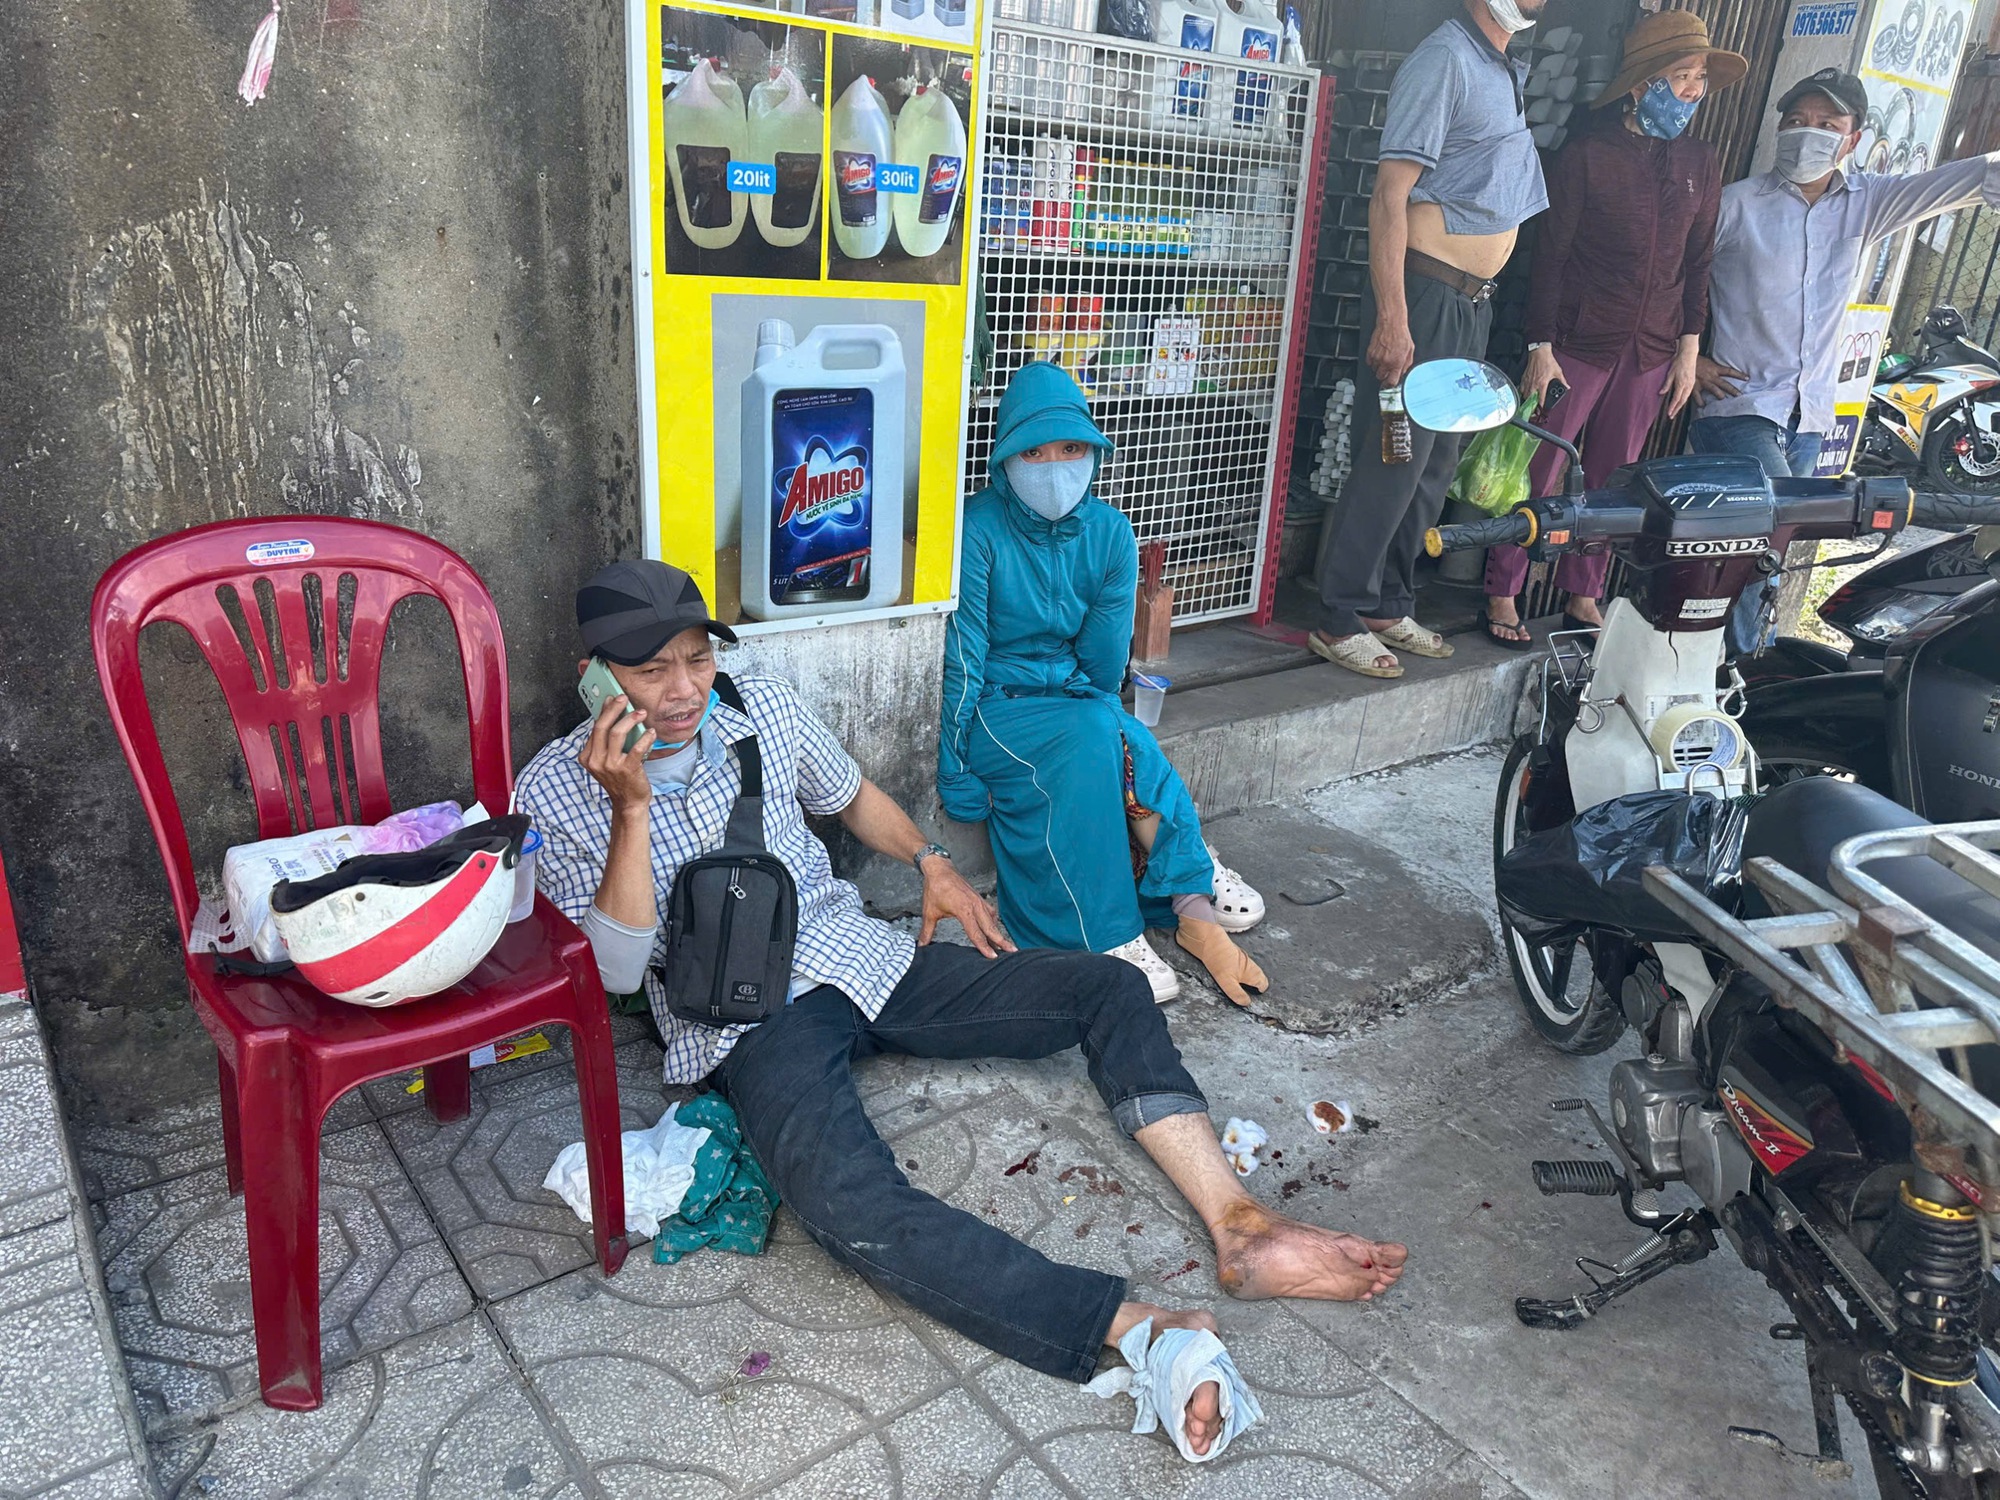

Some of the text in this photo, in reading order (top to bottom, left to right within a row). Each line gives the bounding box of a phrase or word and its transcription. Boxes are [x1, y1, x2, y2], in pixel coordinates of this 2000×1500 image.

[1792, 9, 1857, 37] 0976.566.577
[1246, 45, 1270, 60] AMIGO
[733, 169, 771, 188] 20lit
[842, 165, 871, 184] AMIGO
[881, 170, 914, 188] 30lit
[930, 166, 956, 186] AMIGO
[778, 461, 865, 528] AMIGO
[1668, 538, 1769, 555] HONDA
[1723, 1078, 1765, 1143] Dream
